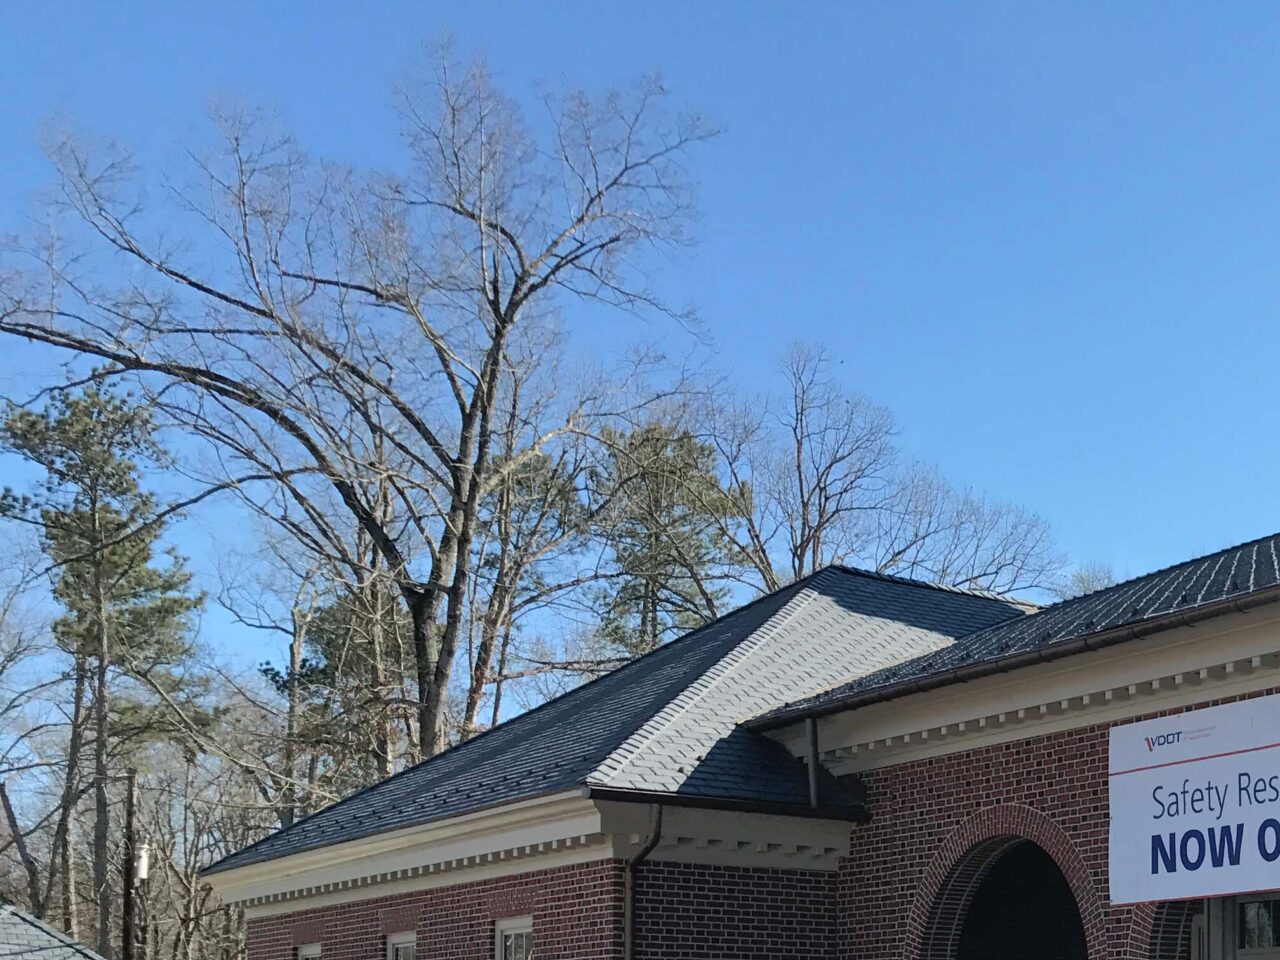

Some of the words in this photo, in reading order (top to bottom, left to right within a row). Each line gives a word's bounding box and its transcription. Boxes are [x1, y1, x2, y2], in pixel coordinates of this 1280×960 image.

[1146, 732, 1182, 752] VDOT
[1152, 780, 1229, 820] Safety
[1151, 823, 1244, 874] NOW
